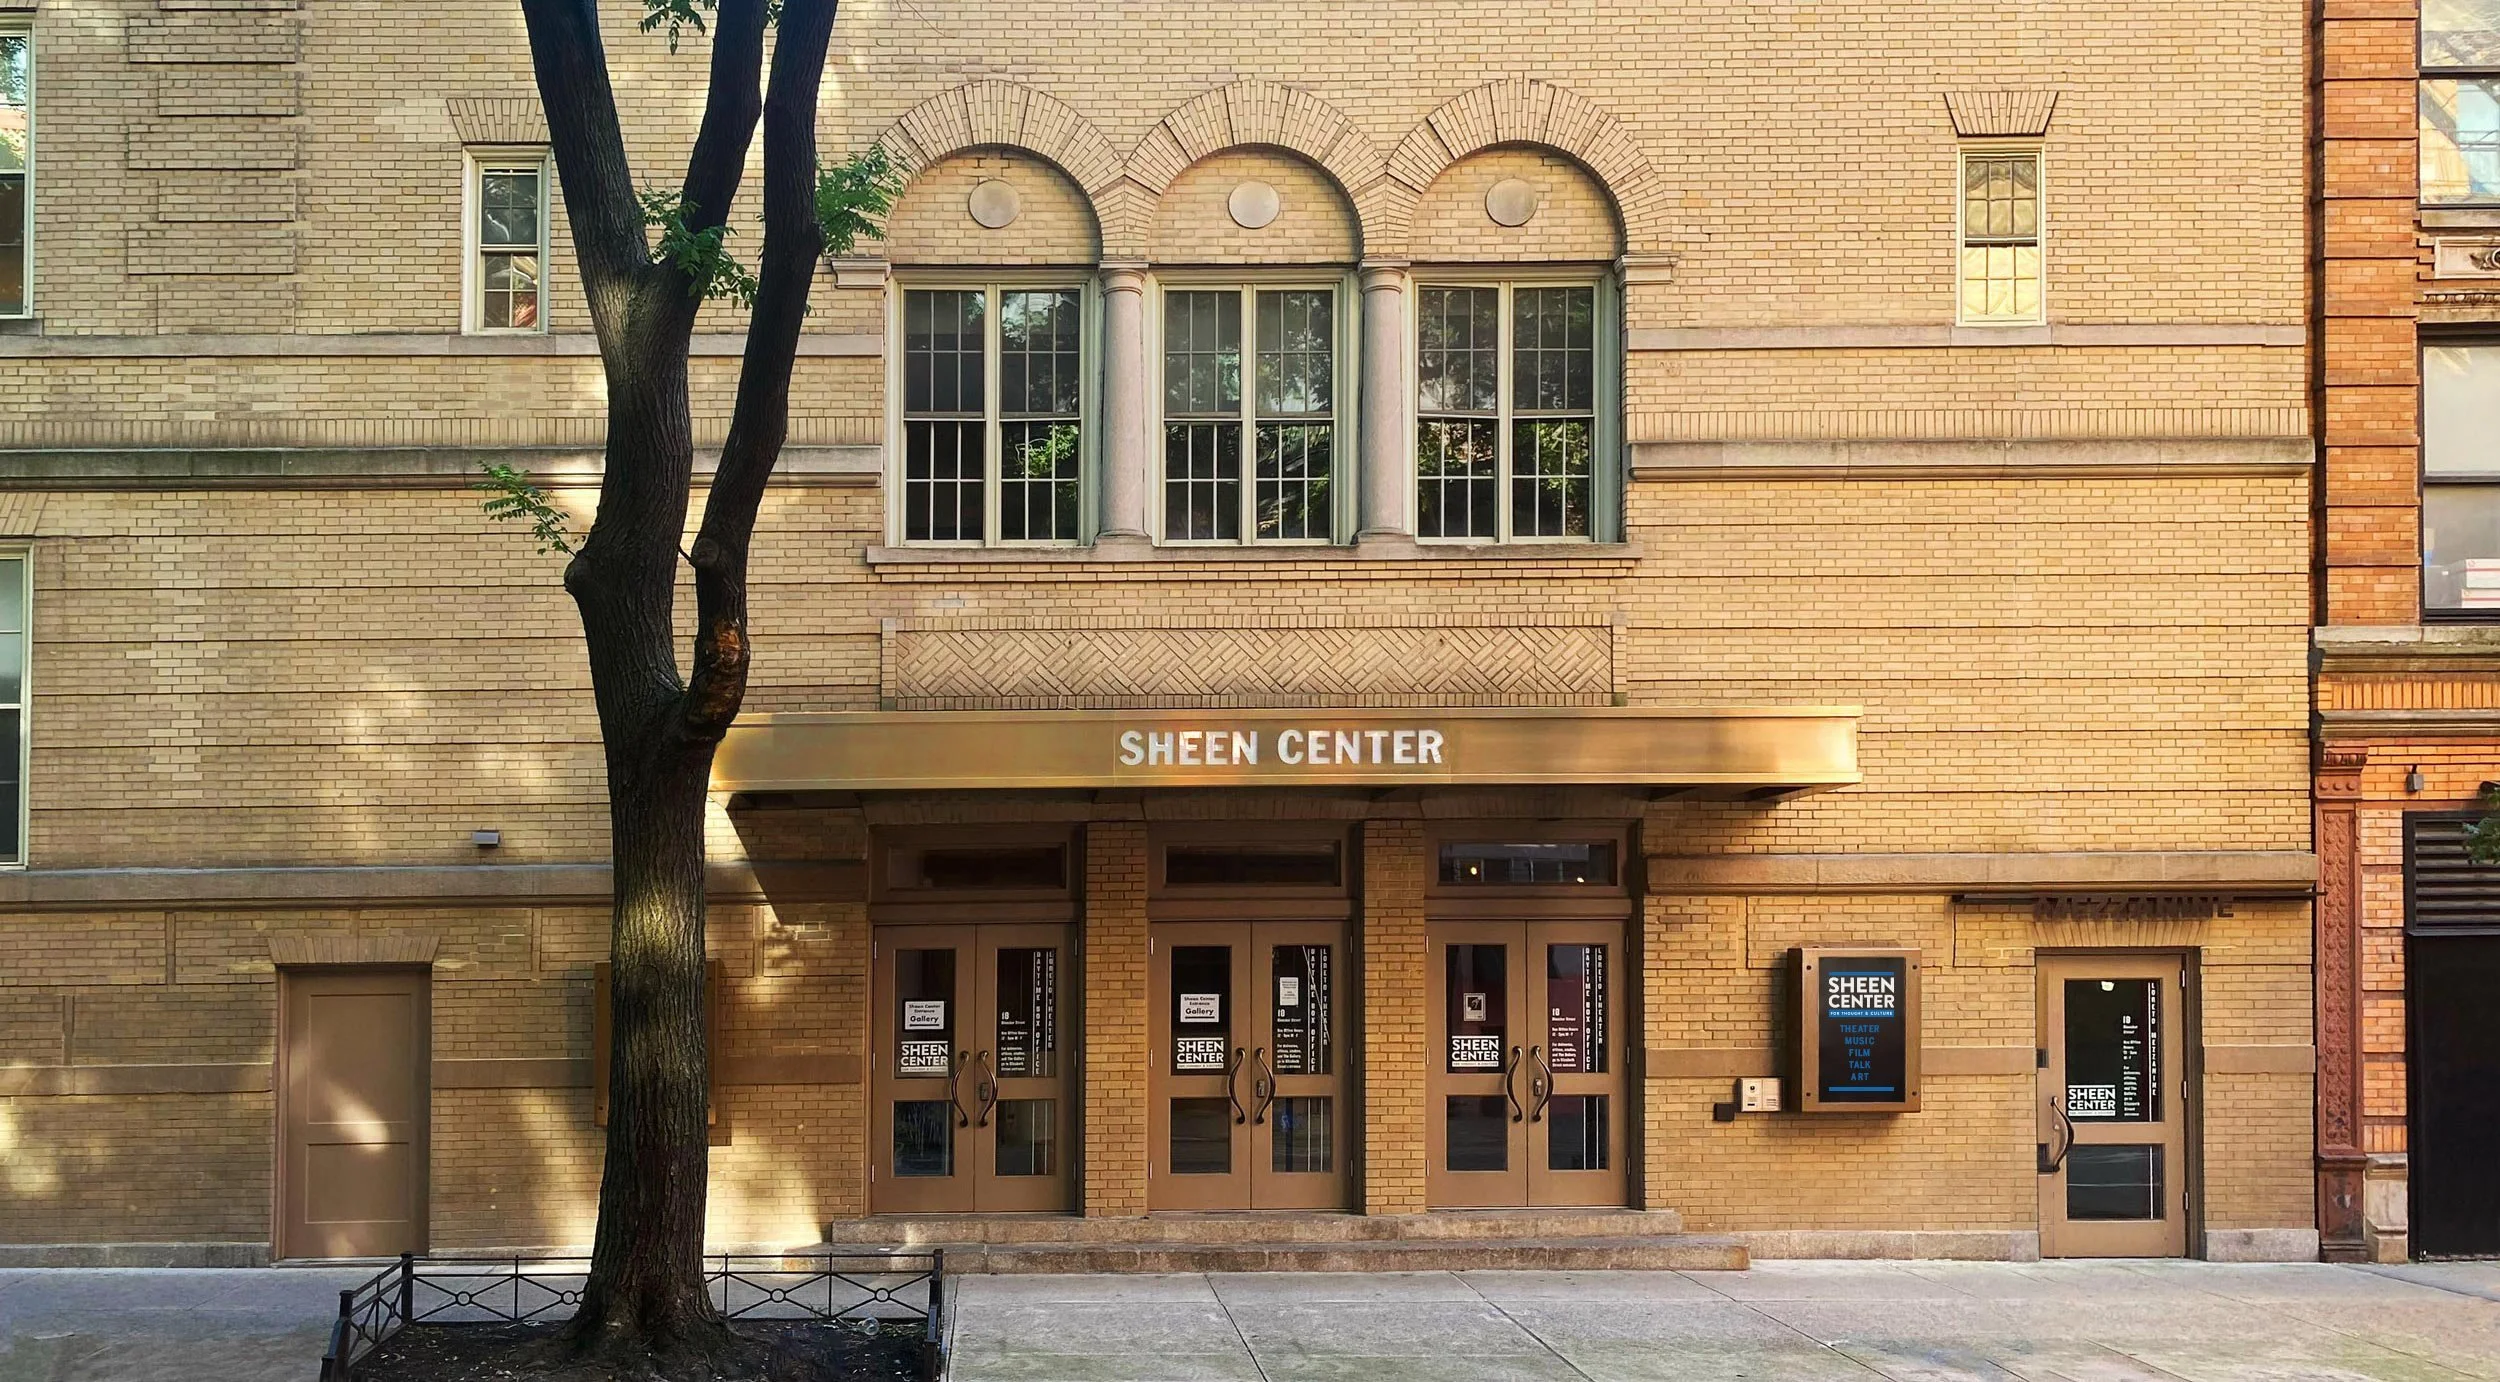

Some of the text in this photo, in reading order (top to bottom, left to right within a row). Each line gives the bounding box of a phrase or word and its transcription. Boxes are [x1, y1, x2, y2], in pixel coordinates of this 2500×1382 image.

[1119, 729, 1445, 766] SHEEN CENTER
[1828, 977, 1895, 993] SHEEN
[1828, 994, 1895, 1009] CENTER
[1840, 1024, 1880, 1033] THEATER
[1452, 1040, 1499, 1051] SHEEN
[1844, 1036, 1875, 1045] MUSIC
[901, 1045, 948, 1056] SHEEN
[1177, 1041, 1224, 1052] SHEEN
[1177, 1053, 1224, 1062] CENTER
[1452, 1051, 1499, 1060] CENTER
[1849, 1048, 1871, 1057] FILM
[901, 1056, 948, 1066] CENTER
[1849, 1060, 1871, 1069] TALK
[1851, 1072, 1870, 1081] ART
[2068, 1089, 2116, 1100] SHEEN
[2068, 1100, 2116, 1110] CENTER
